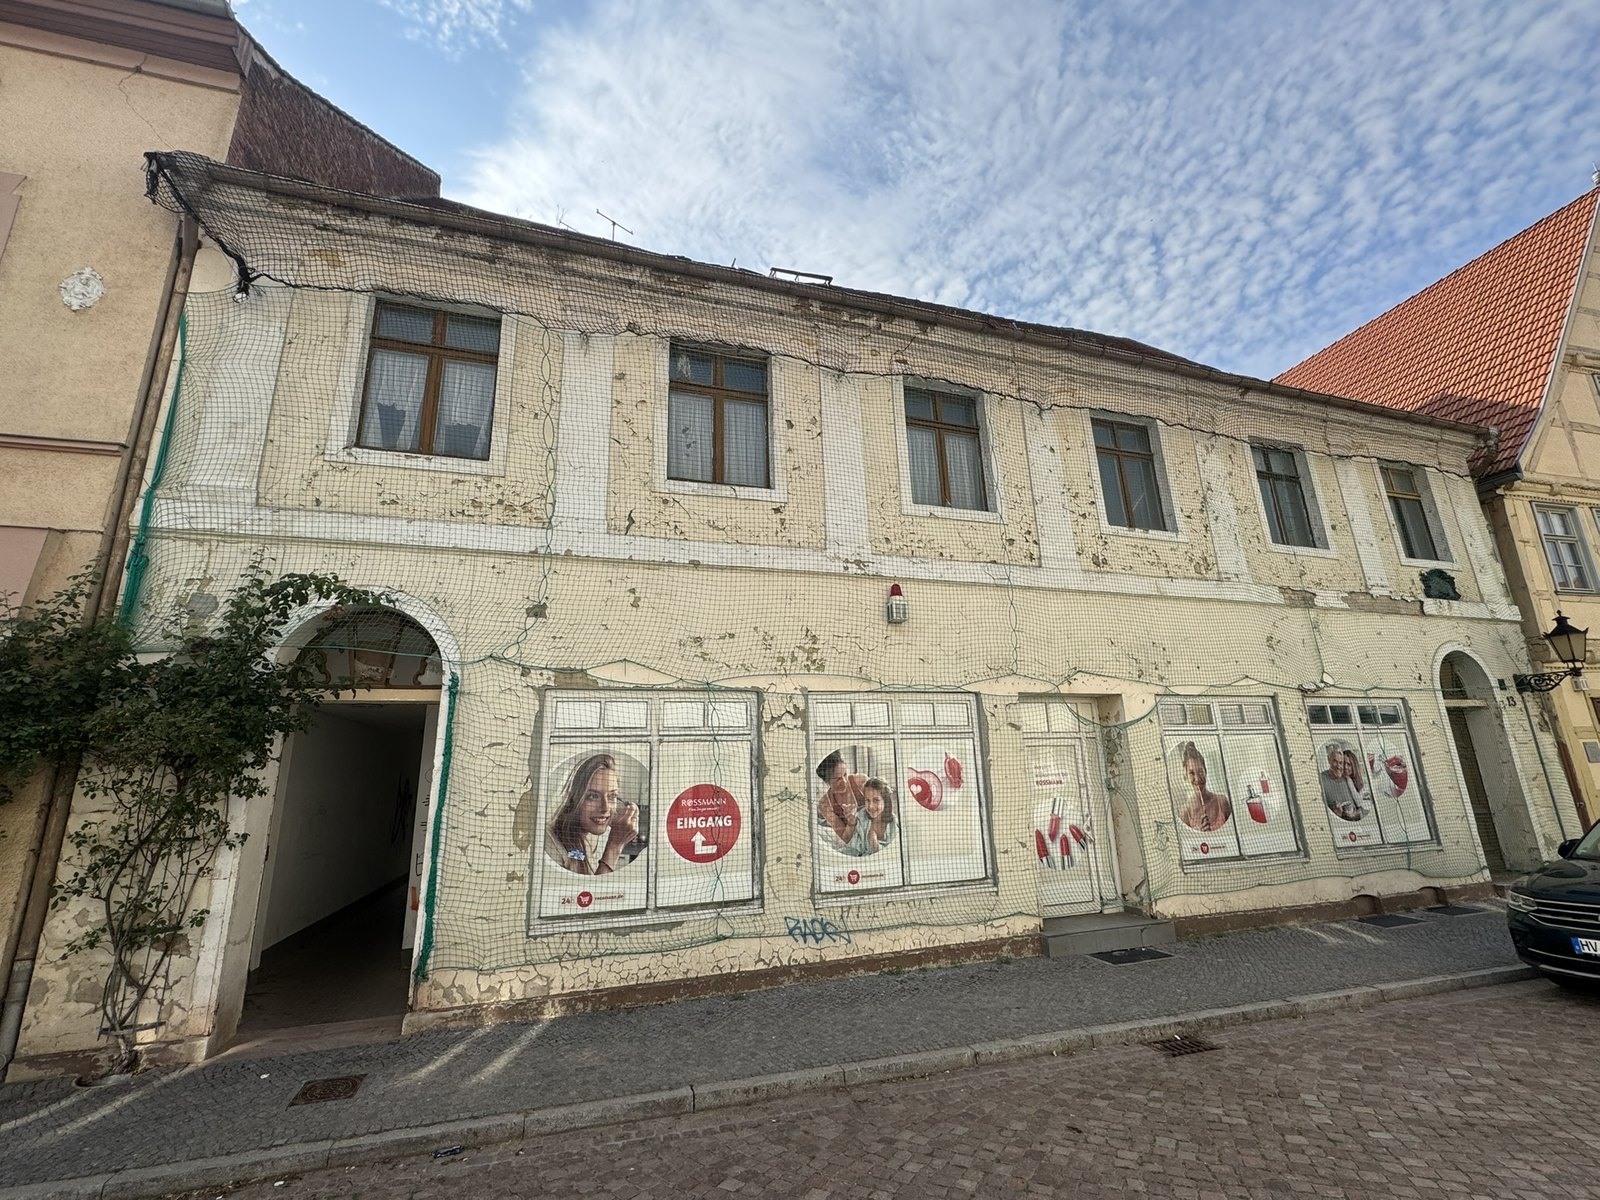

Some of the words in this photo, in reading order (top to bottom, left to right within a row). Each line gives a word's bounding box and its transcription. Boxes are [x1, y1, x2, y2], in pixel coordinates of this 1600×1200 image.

[1506, 696, 1517, 707] 13
[681, 798, 727, 807] ROSSMANN
[676, 815, 733, 830] EINGANG
